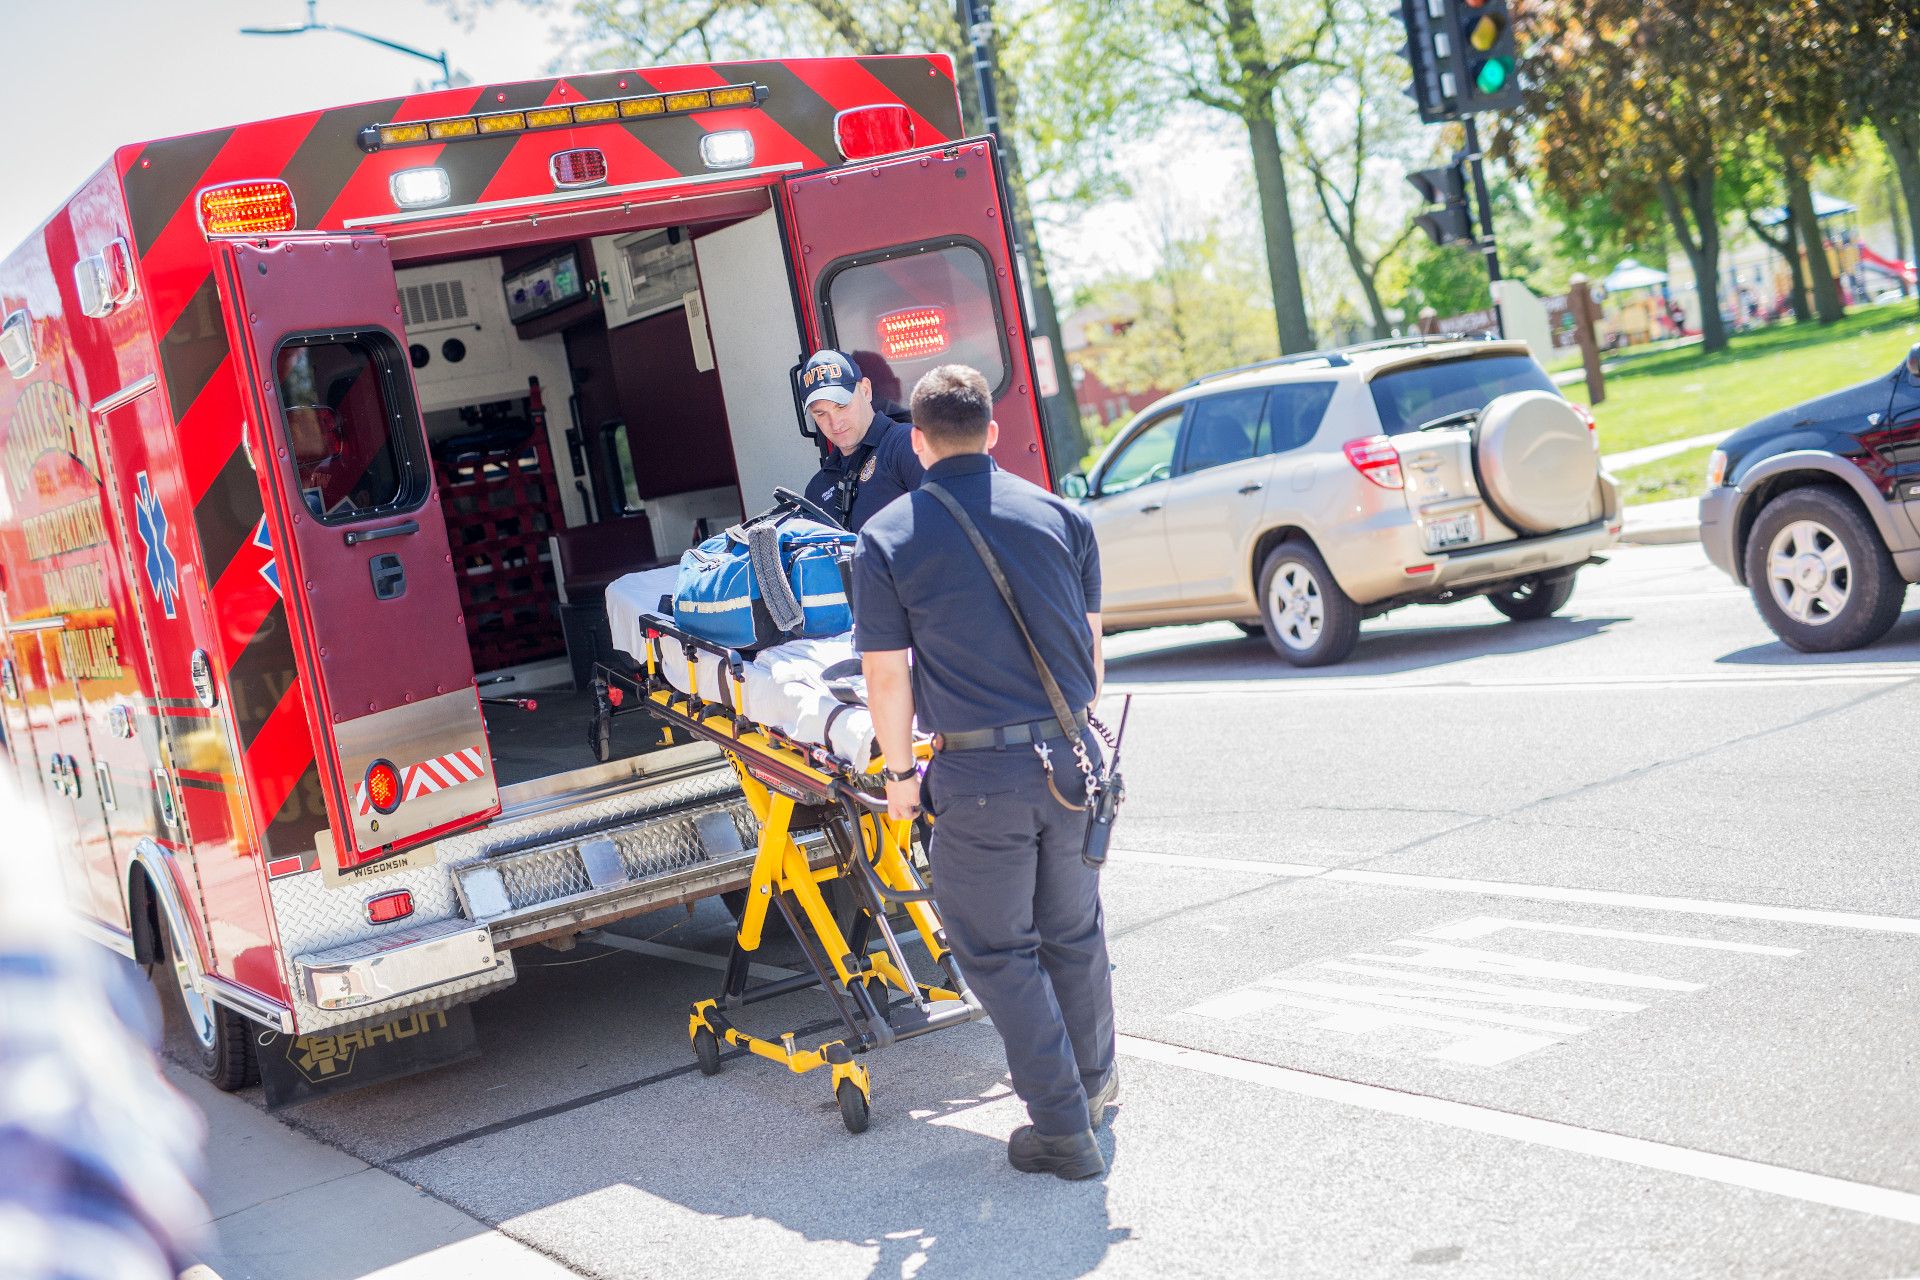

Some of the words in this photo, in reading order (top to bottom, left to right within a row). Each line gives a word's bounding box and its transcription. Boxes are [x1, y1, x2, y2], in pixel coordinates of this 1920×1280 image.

[803, 364, 842, 388] WFD
[353, 858, 409, 878] WISCONSIN
[309, 1008, 448, 1063] BRAUN
